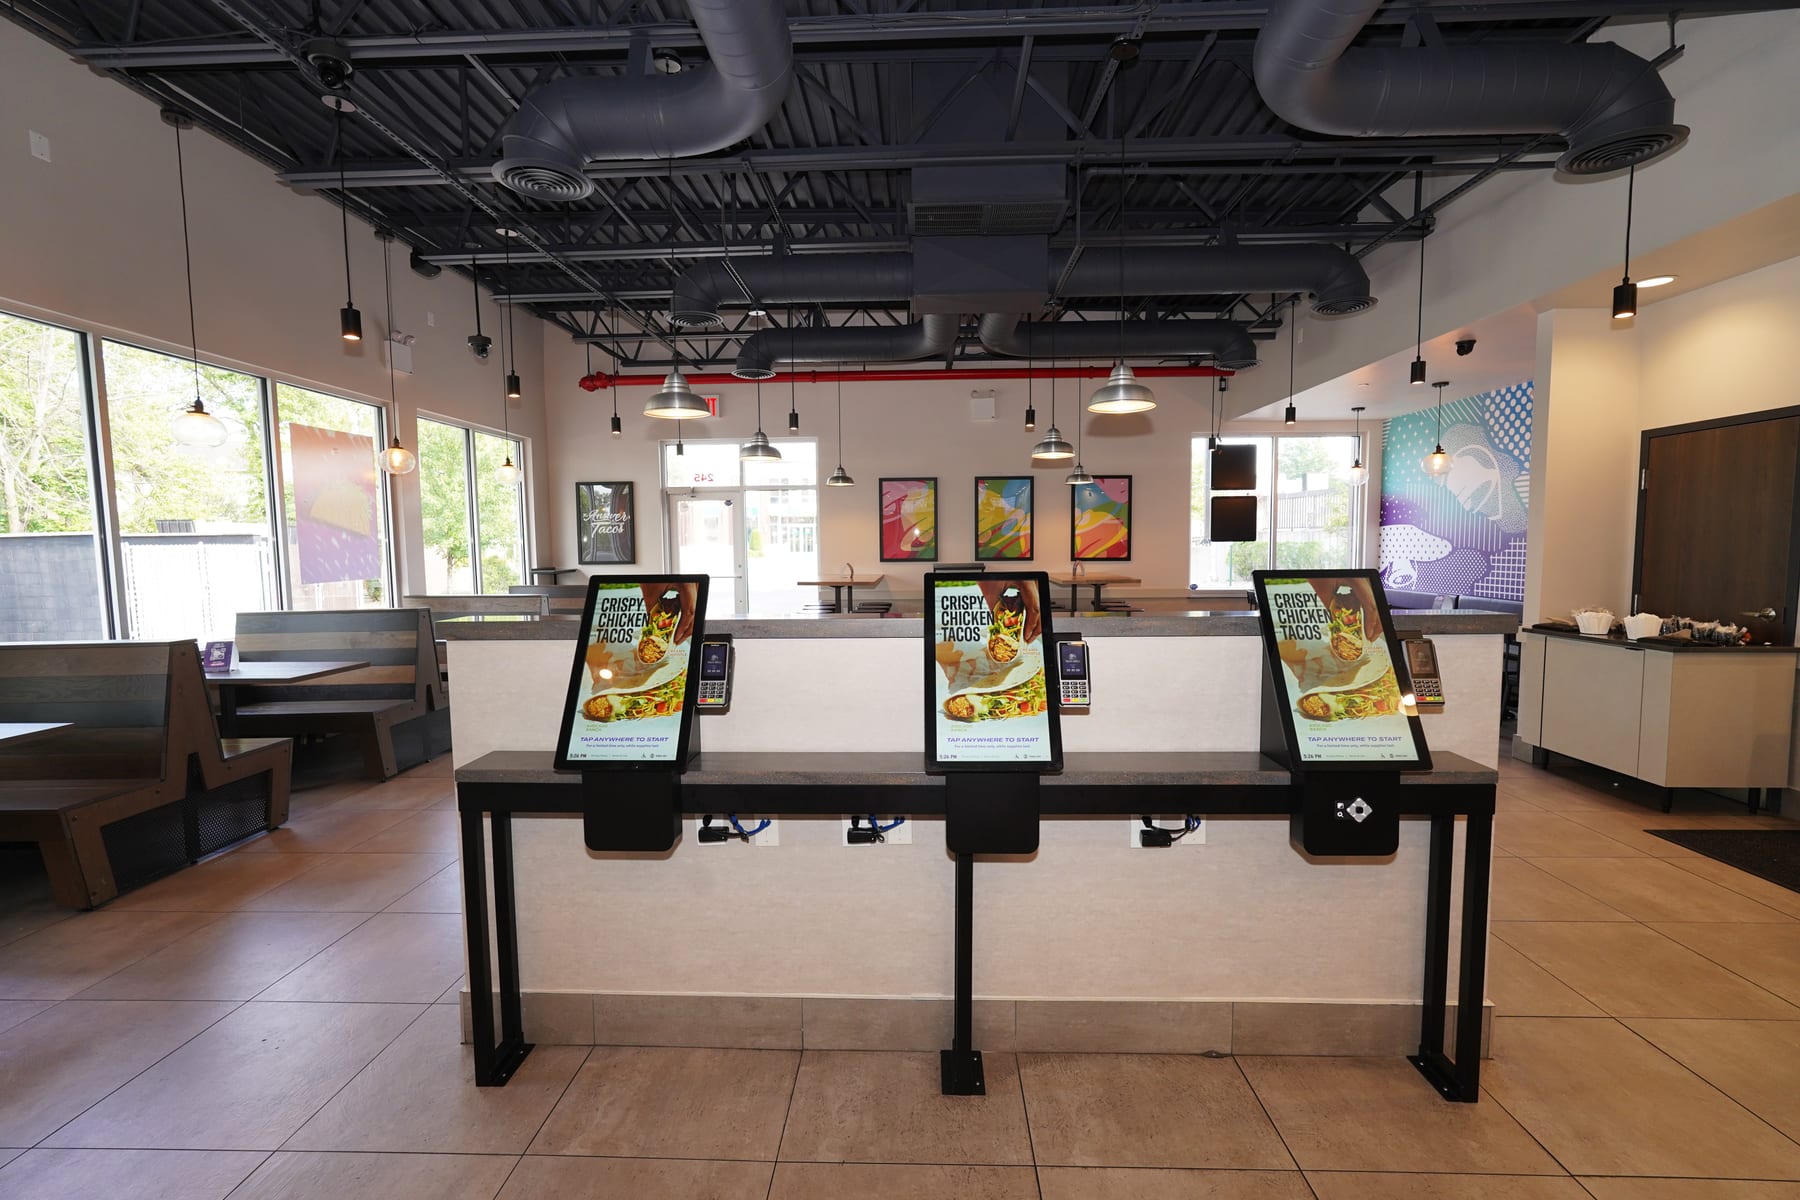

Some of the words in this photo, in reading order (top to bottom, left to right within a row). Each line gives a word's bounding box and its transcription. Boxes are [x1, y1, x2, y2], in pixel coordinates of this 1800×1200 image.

[591, 522, 625, 538] Tacos
[600, 597, 645, 612] CRISPY
[941, 595, 985, 610] CRISPY
[1273, 593, 1319, 608] CRISPY
[598, 612, 650, 628] CHICKEN
[941, 610, 995, 626] CHICKEN
[1277, 608, 1333, 624] CHICKEN
[596, 628, 634, 643] TACOS
[941, 626, 981, 642] TACOS
[1282, 624, 1322, 640] TACOS
